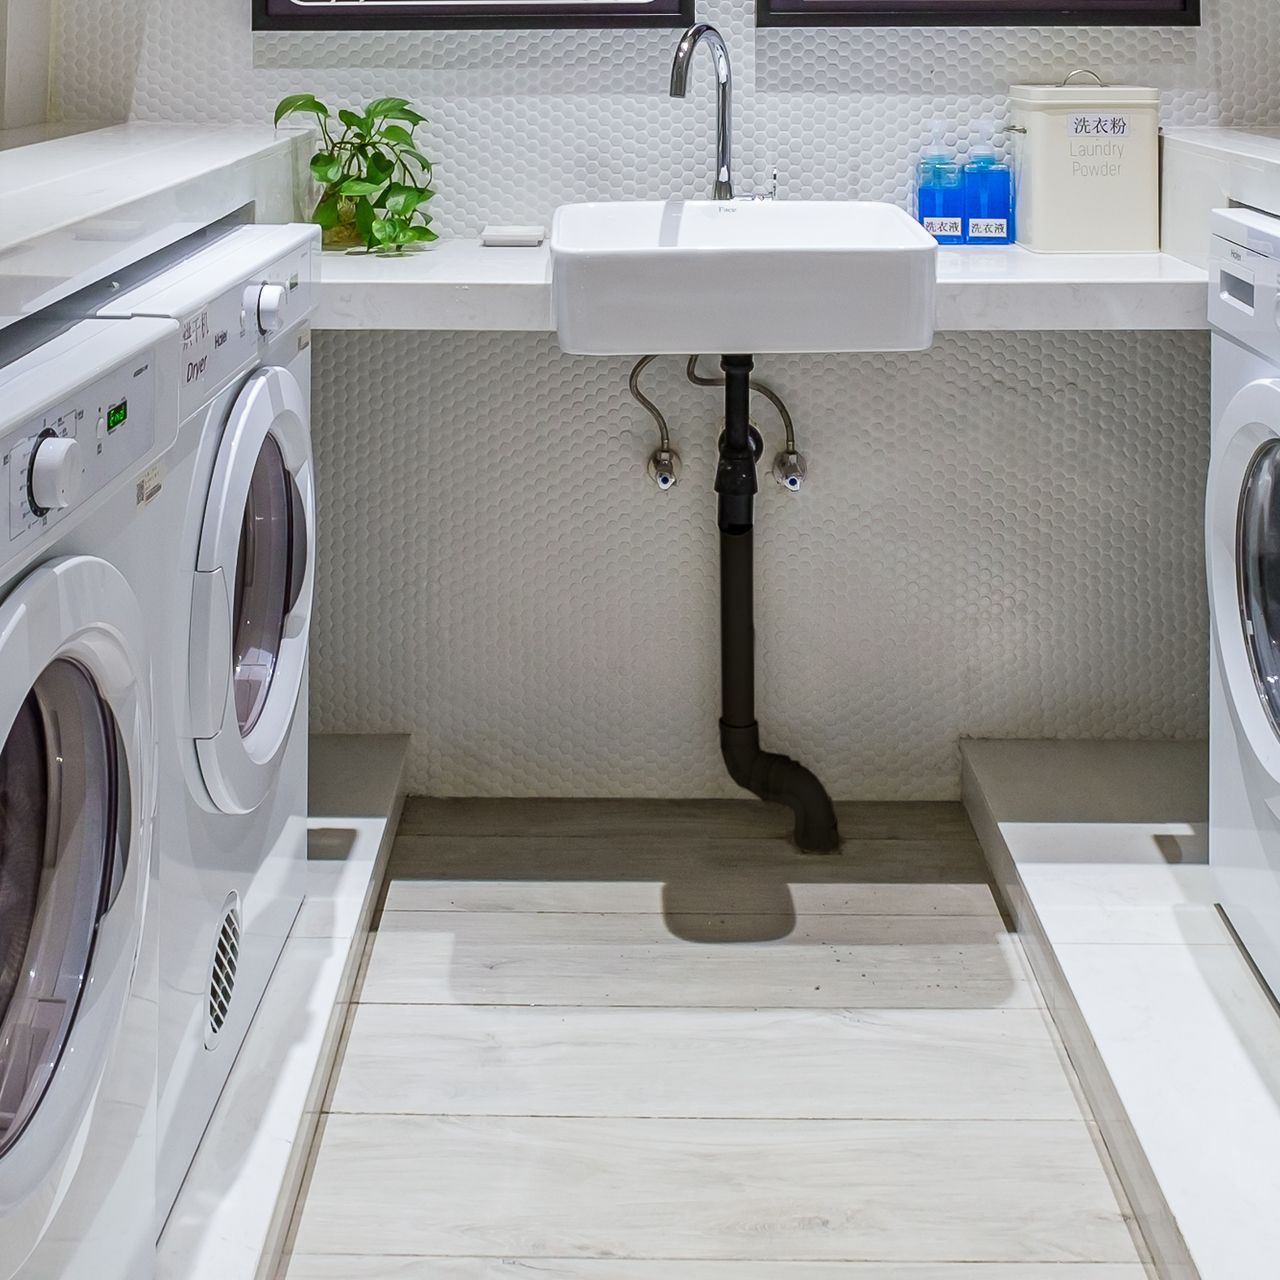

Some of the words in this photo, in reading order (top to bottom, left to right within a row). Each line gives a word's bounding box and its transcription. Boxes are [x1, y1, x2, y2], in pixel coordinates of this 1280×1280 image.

[1073, 116, 1127, 135] 洗衣粉
[1070, 140, 1124, 159] Laundry
[1073, 161, 1122, 177] Powder
[925, 221, 960, 233] 洗衣液
[971, 222, 1005, 235] 洗衣液
[186, 355, 208, 383] Dryer
